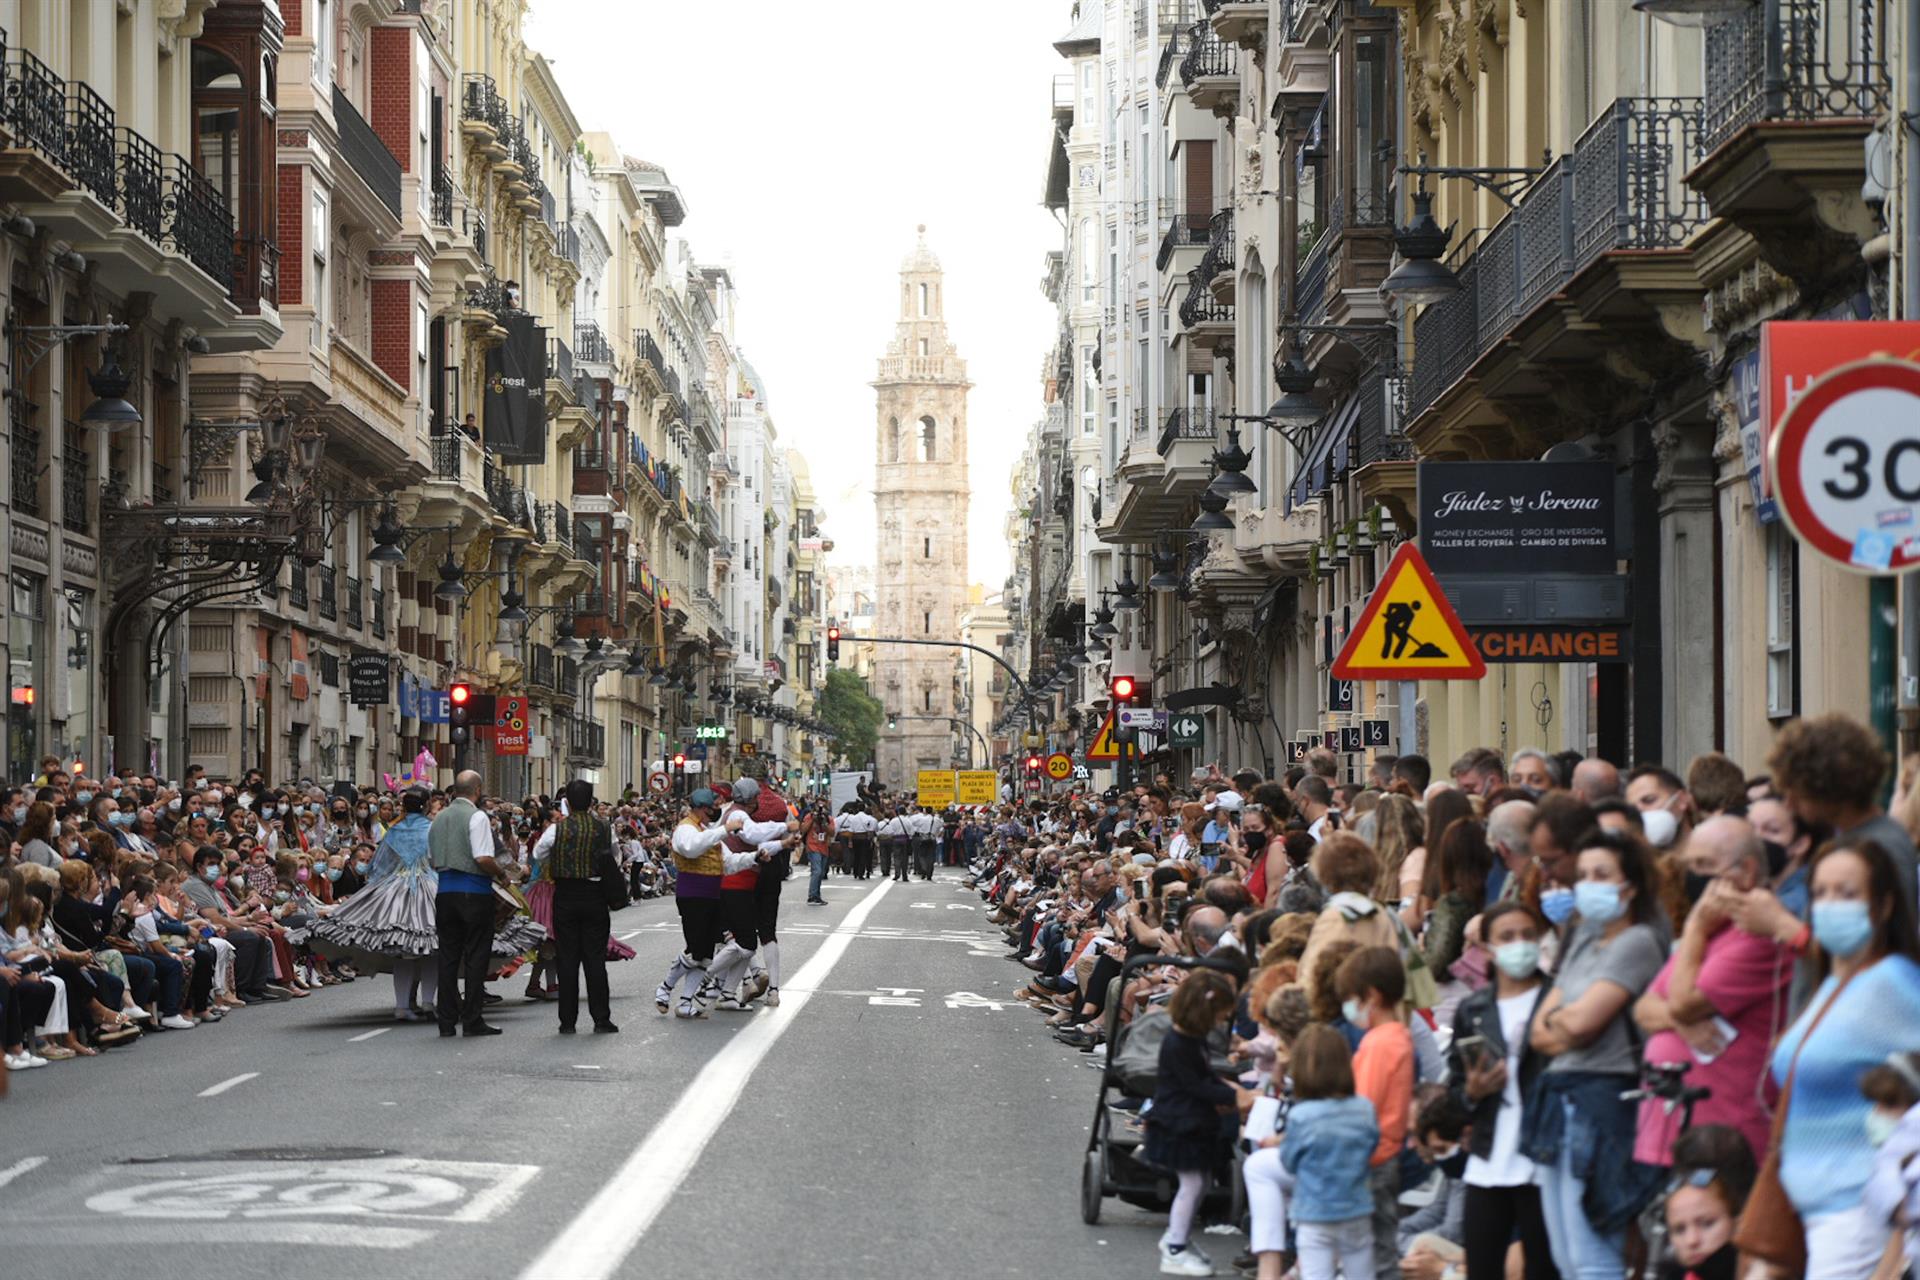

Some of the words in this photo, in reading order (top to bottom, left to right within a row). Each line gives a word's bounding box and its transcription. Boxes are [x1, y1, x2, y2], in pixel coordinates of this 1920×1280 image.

[501, 377, 525, 387] nest
[1823, 437, 1920, 503] 30
[1434, 491, 1504, 518] Júdez
[1528, 490, 1601, 511] Serena
[1467, 529, 1515, 537] EXCHANGE
[1521, 528, 1542, 536] ORO
[1543, 528, 1554, 536] DE
[1431, 539, 1463, 547] TALLER
[1464, 539, 1476, 547] DE
[1520, 538, 1556, 546] CAMBIO
[497, 735, 525, 745] nest
[1051, 762, 1067, 771] 20
